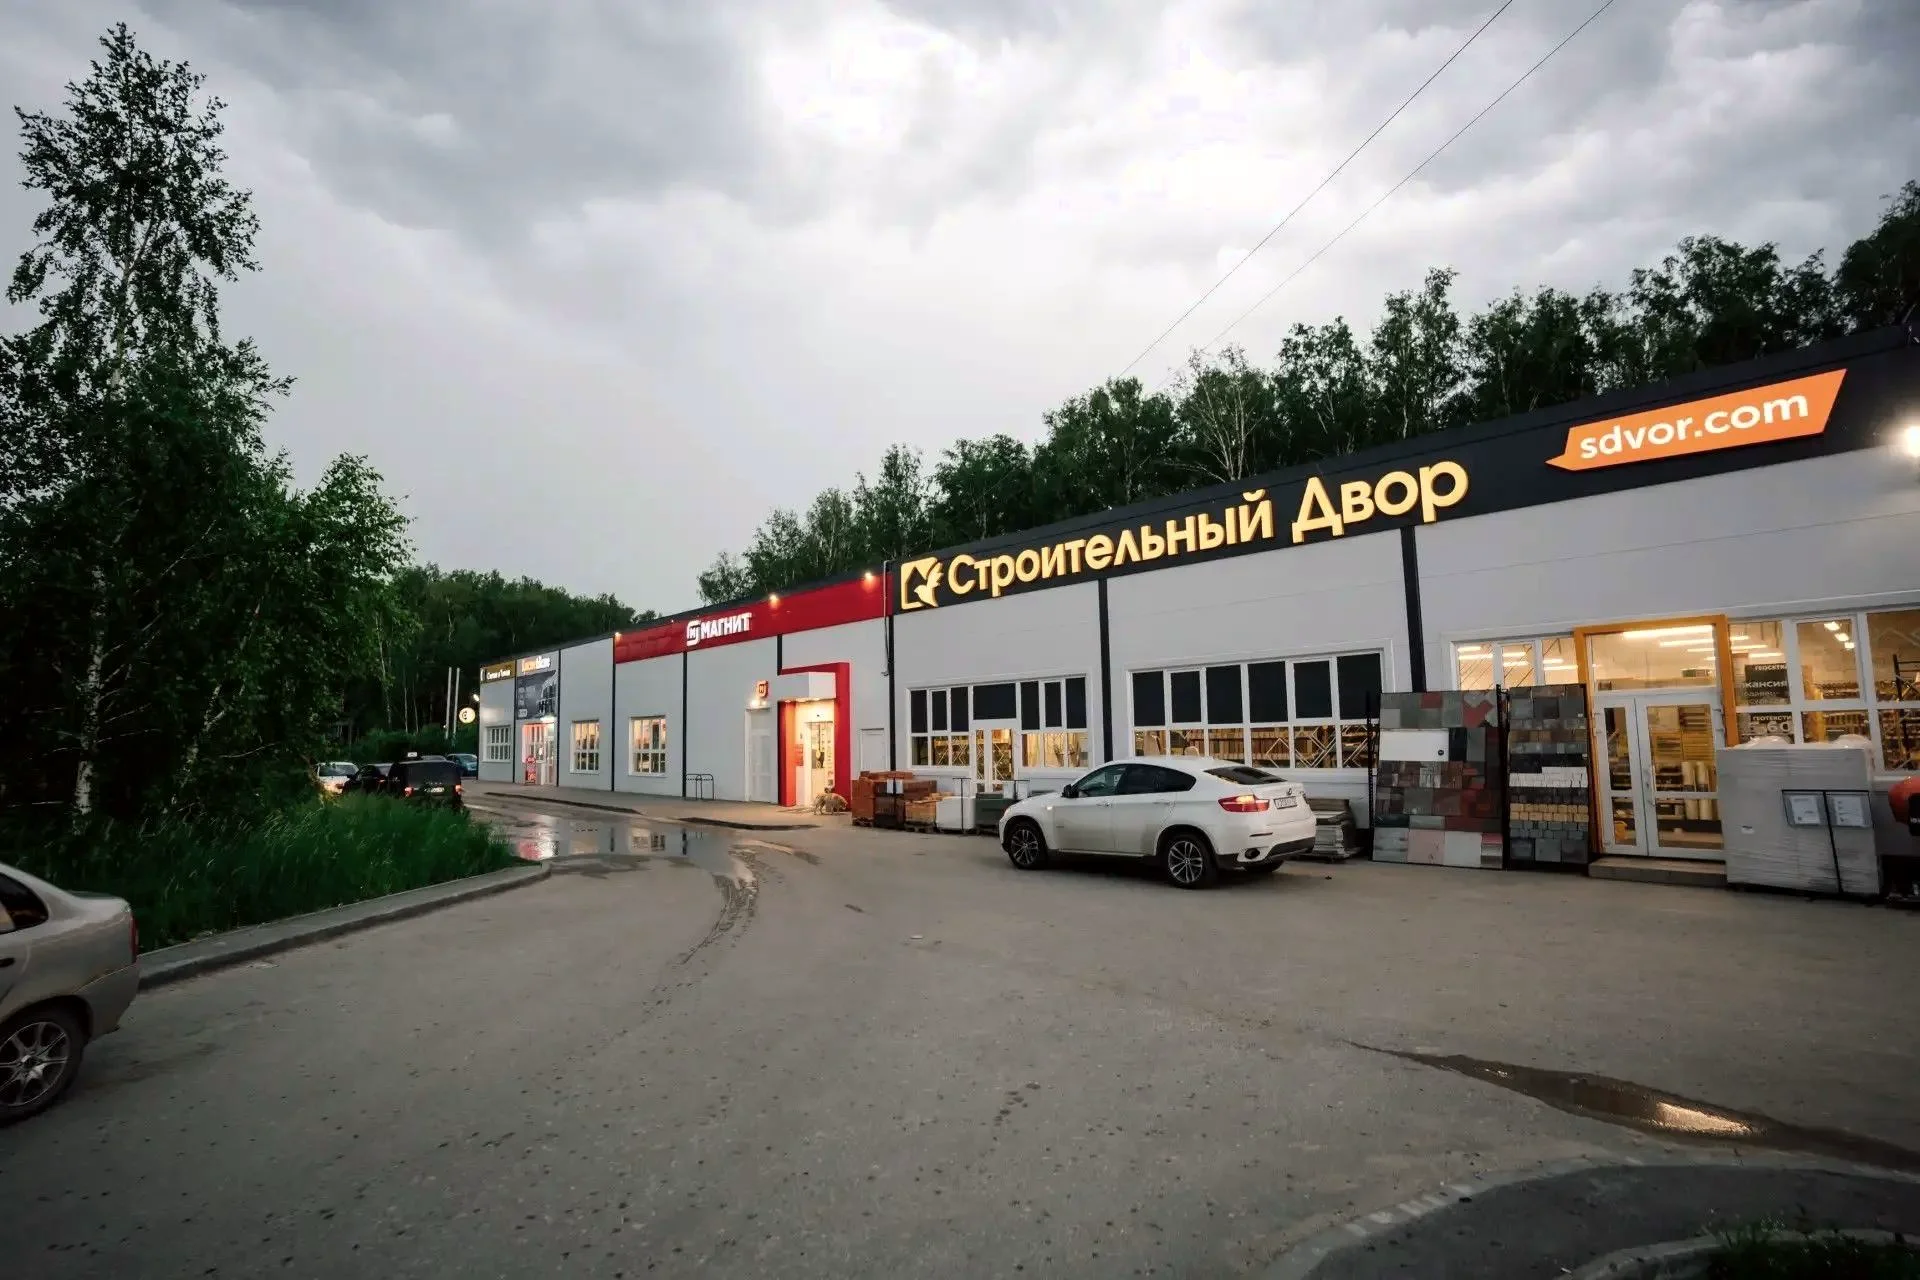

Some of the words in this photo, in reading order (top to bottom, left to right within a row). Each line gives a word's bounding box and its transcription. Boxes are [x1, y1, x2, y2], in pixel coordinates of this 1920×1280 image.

[1581, 394, 1809, 460] sdvor.com
[947, 489, 1274, 597] Строительный
[1291, 461, 1470, 543] Двор
[700, 613, 753, 638] МАГНИТ
